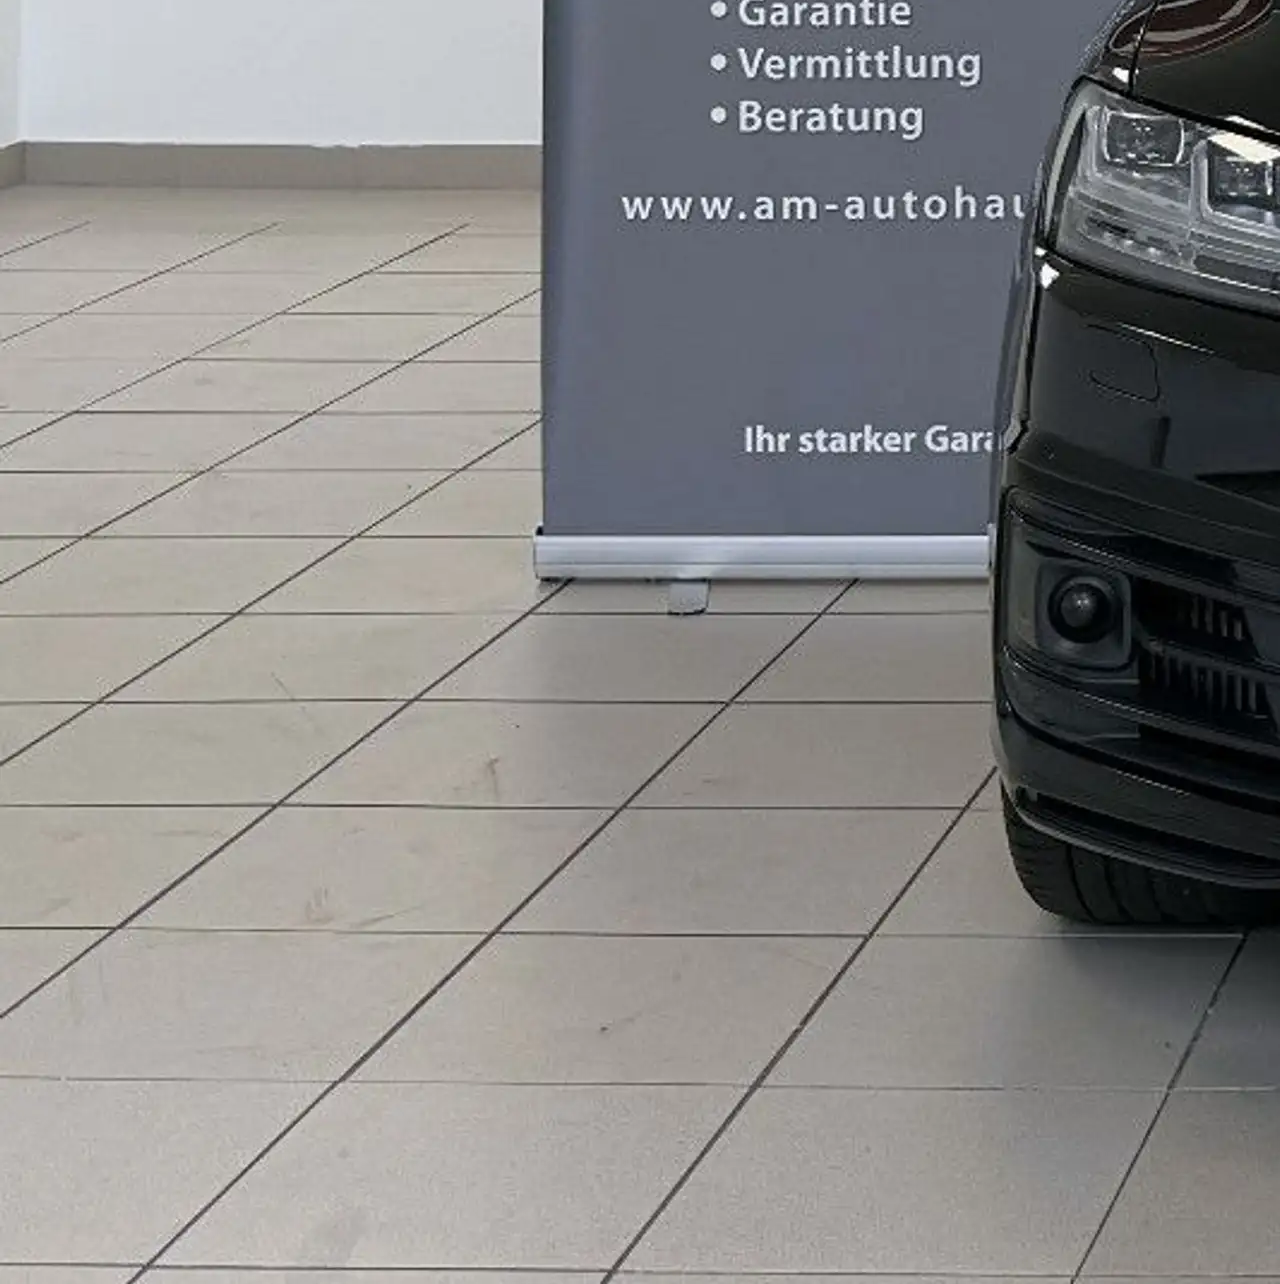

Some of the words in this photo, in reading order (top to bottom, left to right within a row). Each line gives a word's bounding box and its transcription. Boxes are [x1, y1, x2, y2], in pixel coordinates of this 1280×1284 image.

[737, 44, 982, 87] Vermittlung
[738, 99, 924, 141] Beratung
[745, 423, 791, 454] Ihr
[798, 423, 917, 455] starker
